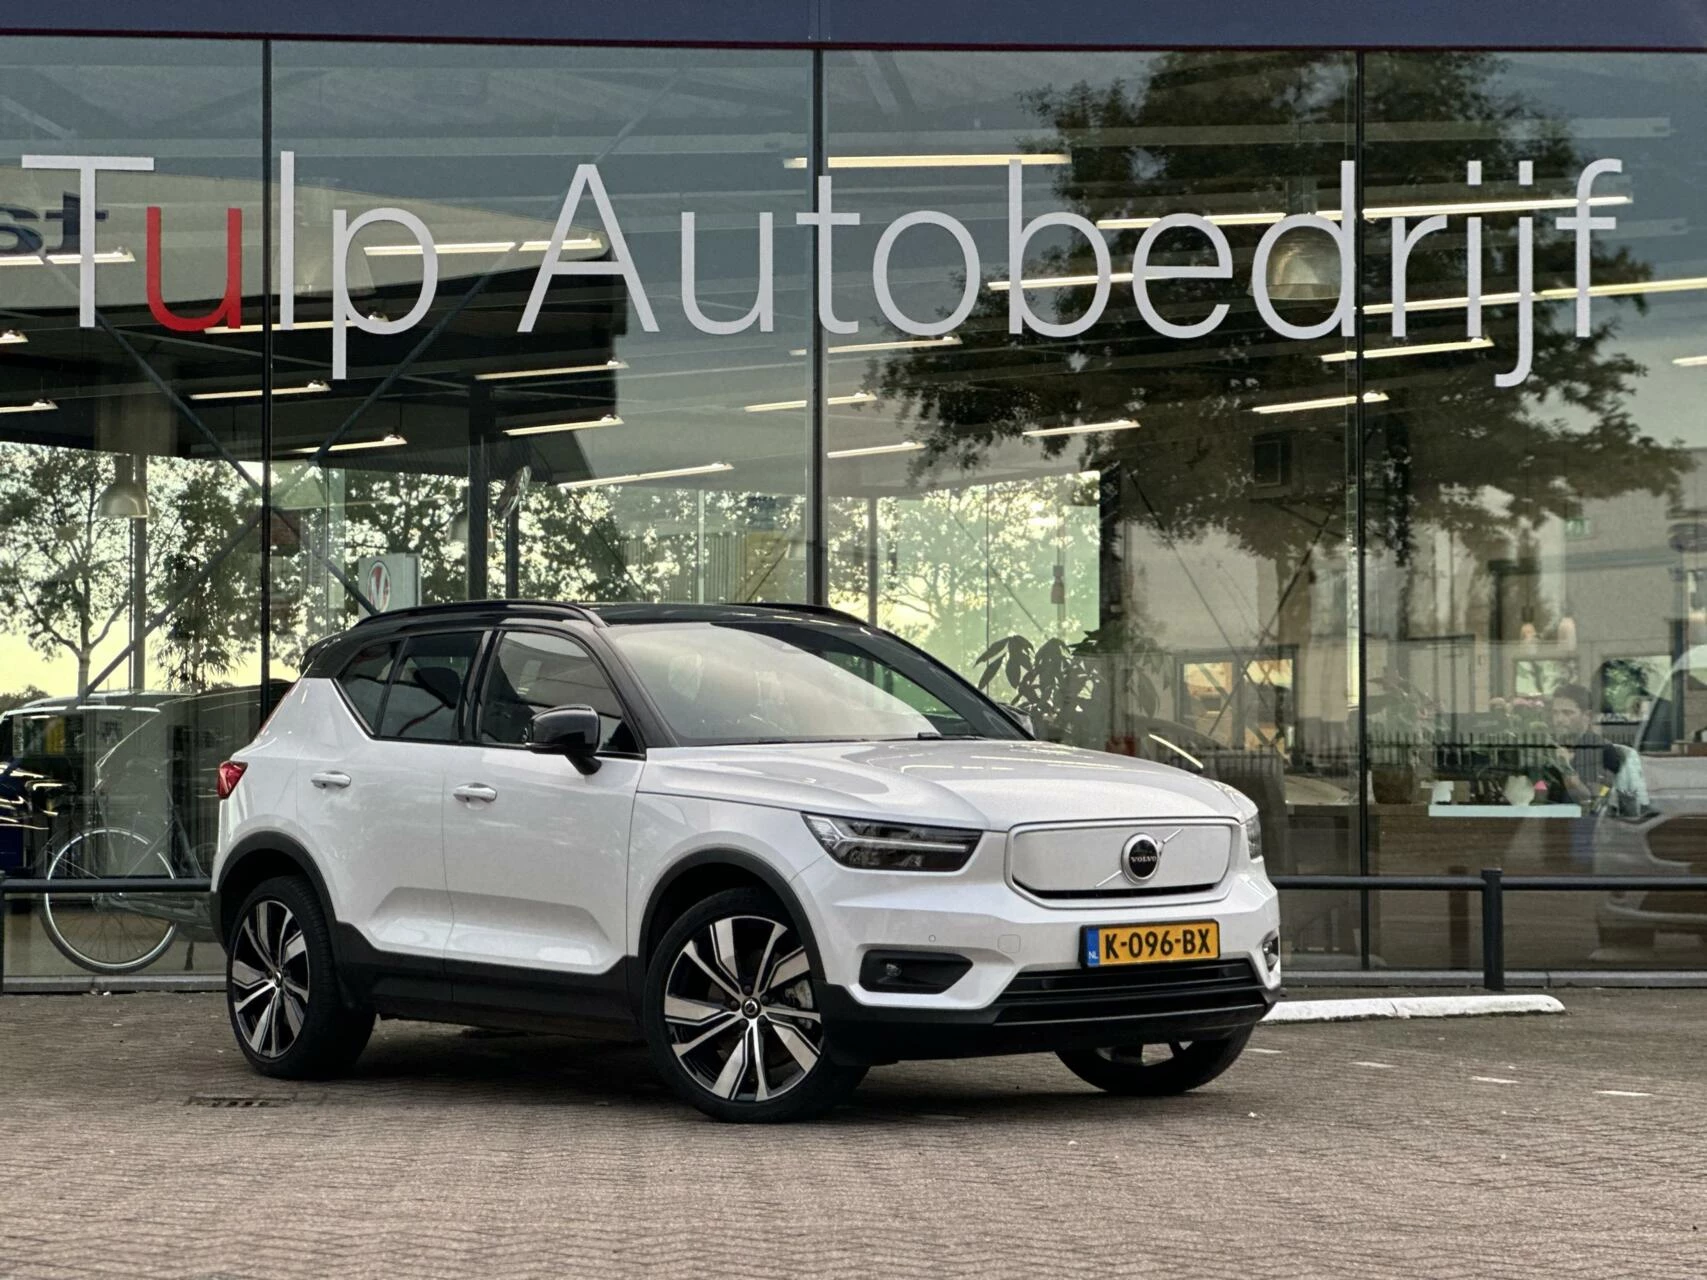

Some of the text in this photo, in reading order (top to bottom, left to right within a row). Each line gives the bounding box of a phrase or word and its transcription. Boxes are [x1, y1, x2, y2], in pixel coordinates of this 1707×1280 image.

[21, 150, 1623, 388] Tulp Autobedrijf
[1130, 855, 1158, 863] VOLVO
[1087, 928, 1211, 960] NL K-096-BX
